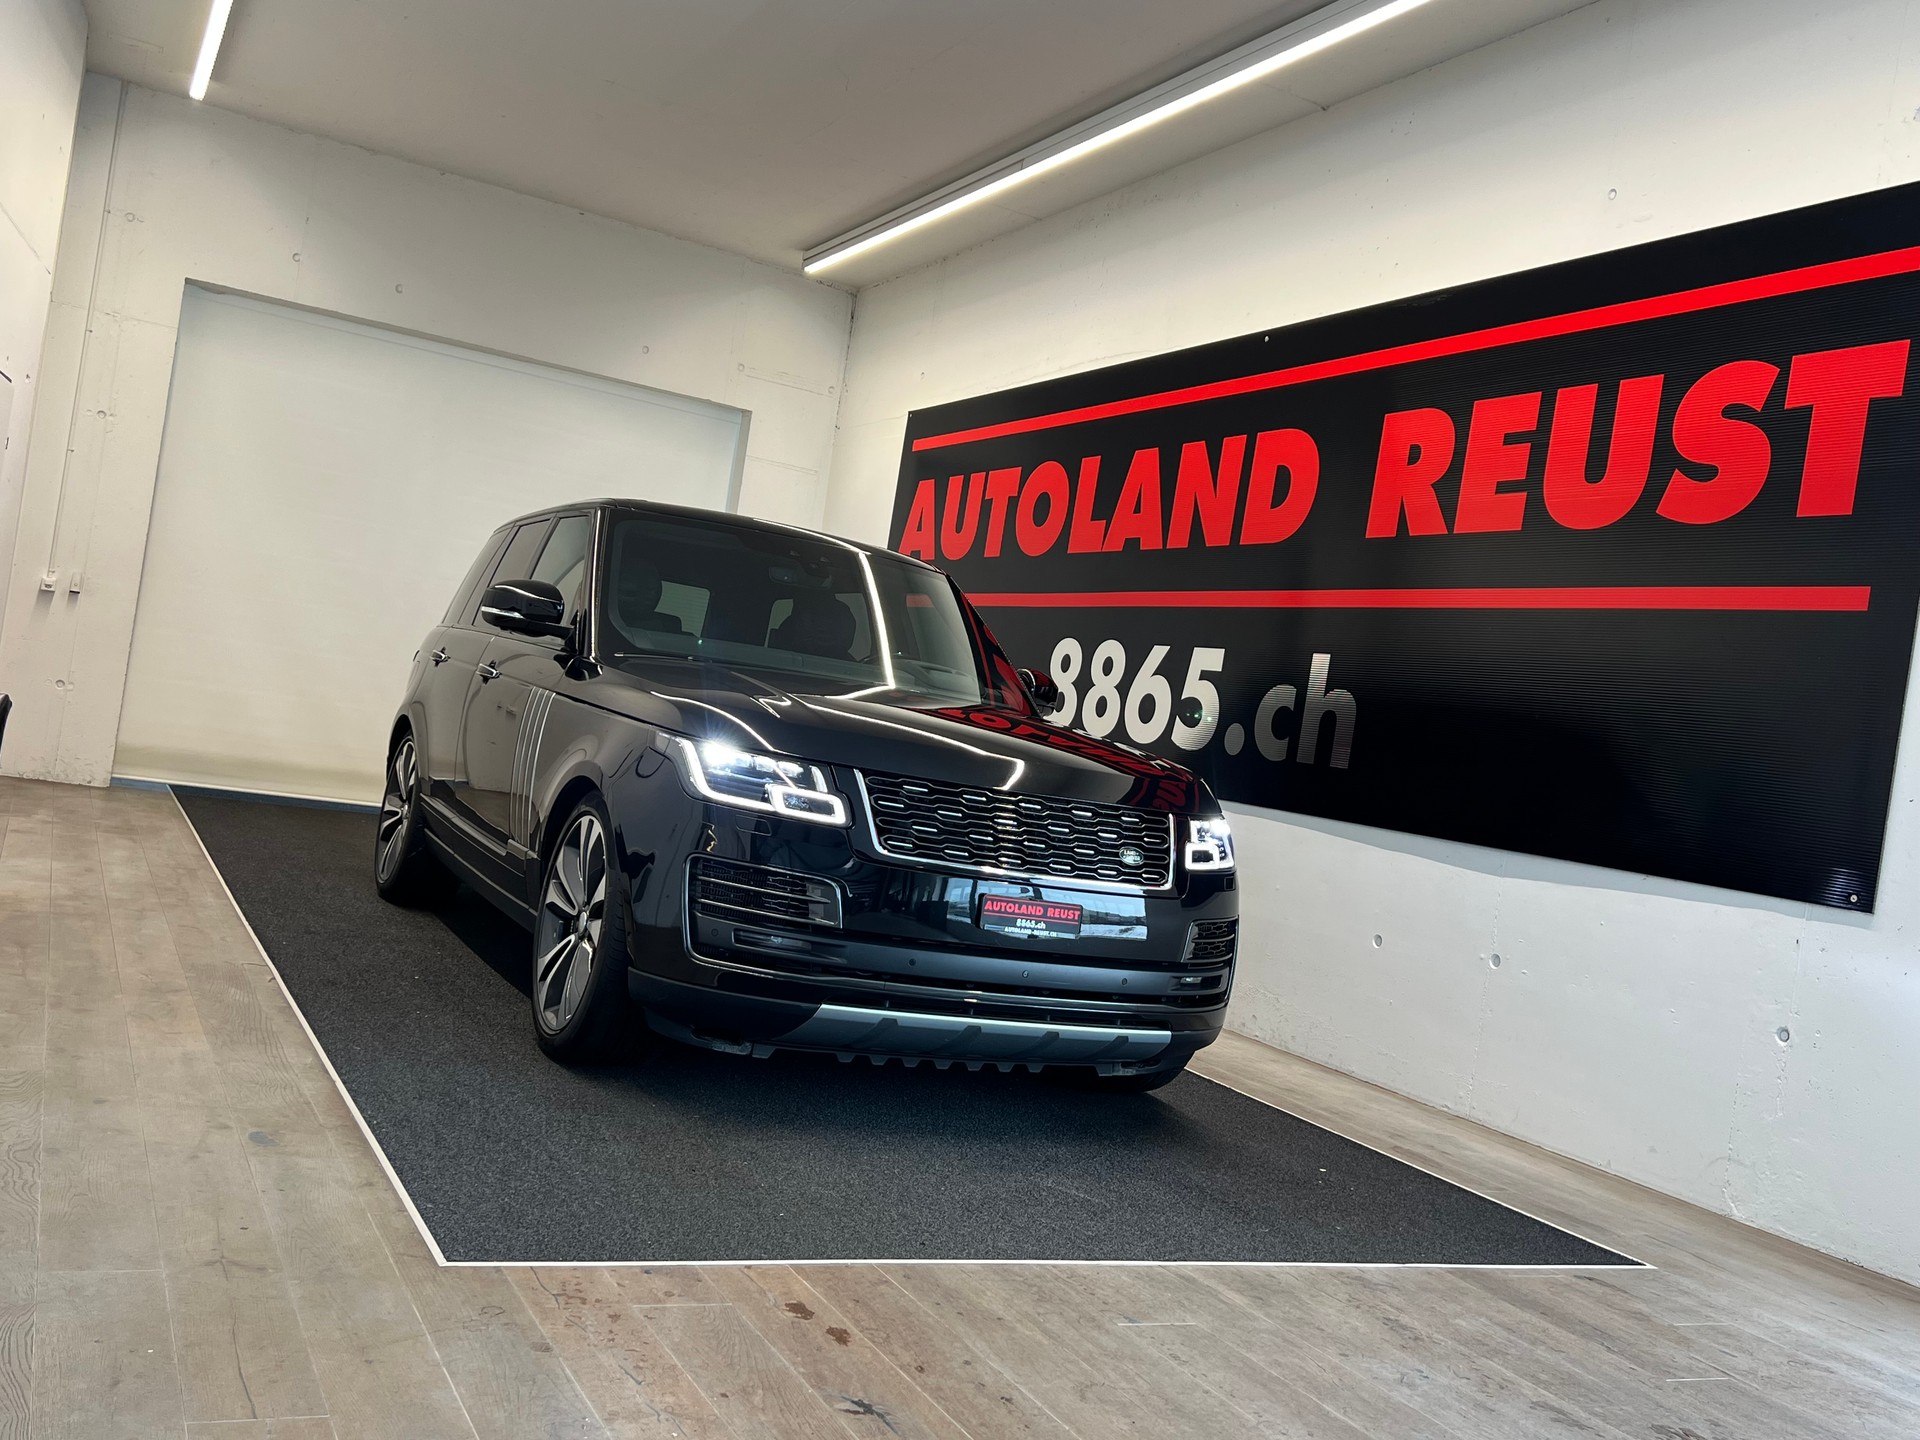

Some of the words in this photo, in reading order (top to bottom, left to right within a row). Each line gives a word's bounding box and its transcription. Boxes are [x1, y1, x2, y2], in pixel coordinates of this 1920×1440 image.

[899, 428, 1320, 561] AUTOLAND
[1365, 339, 1911, 538] REUST
[1043, 637, 1357, 769] 8865.ch
[984, 901, 1044, 916] AUTOLAND
[1047, 907, 1080, 920] REUST
[1016, 918, 1046, 929] 8865.ch
